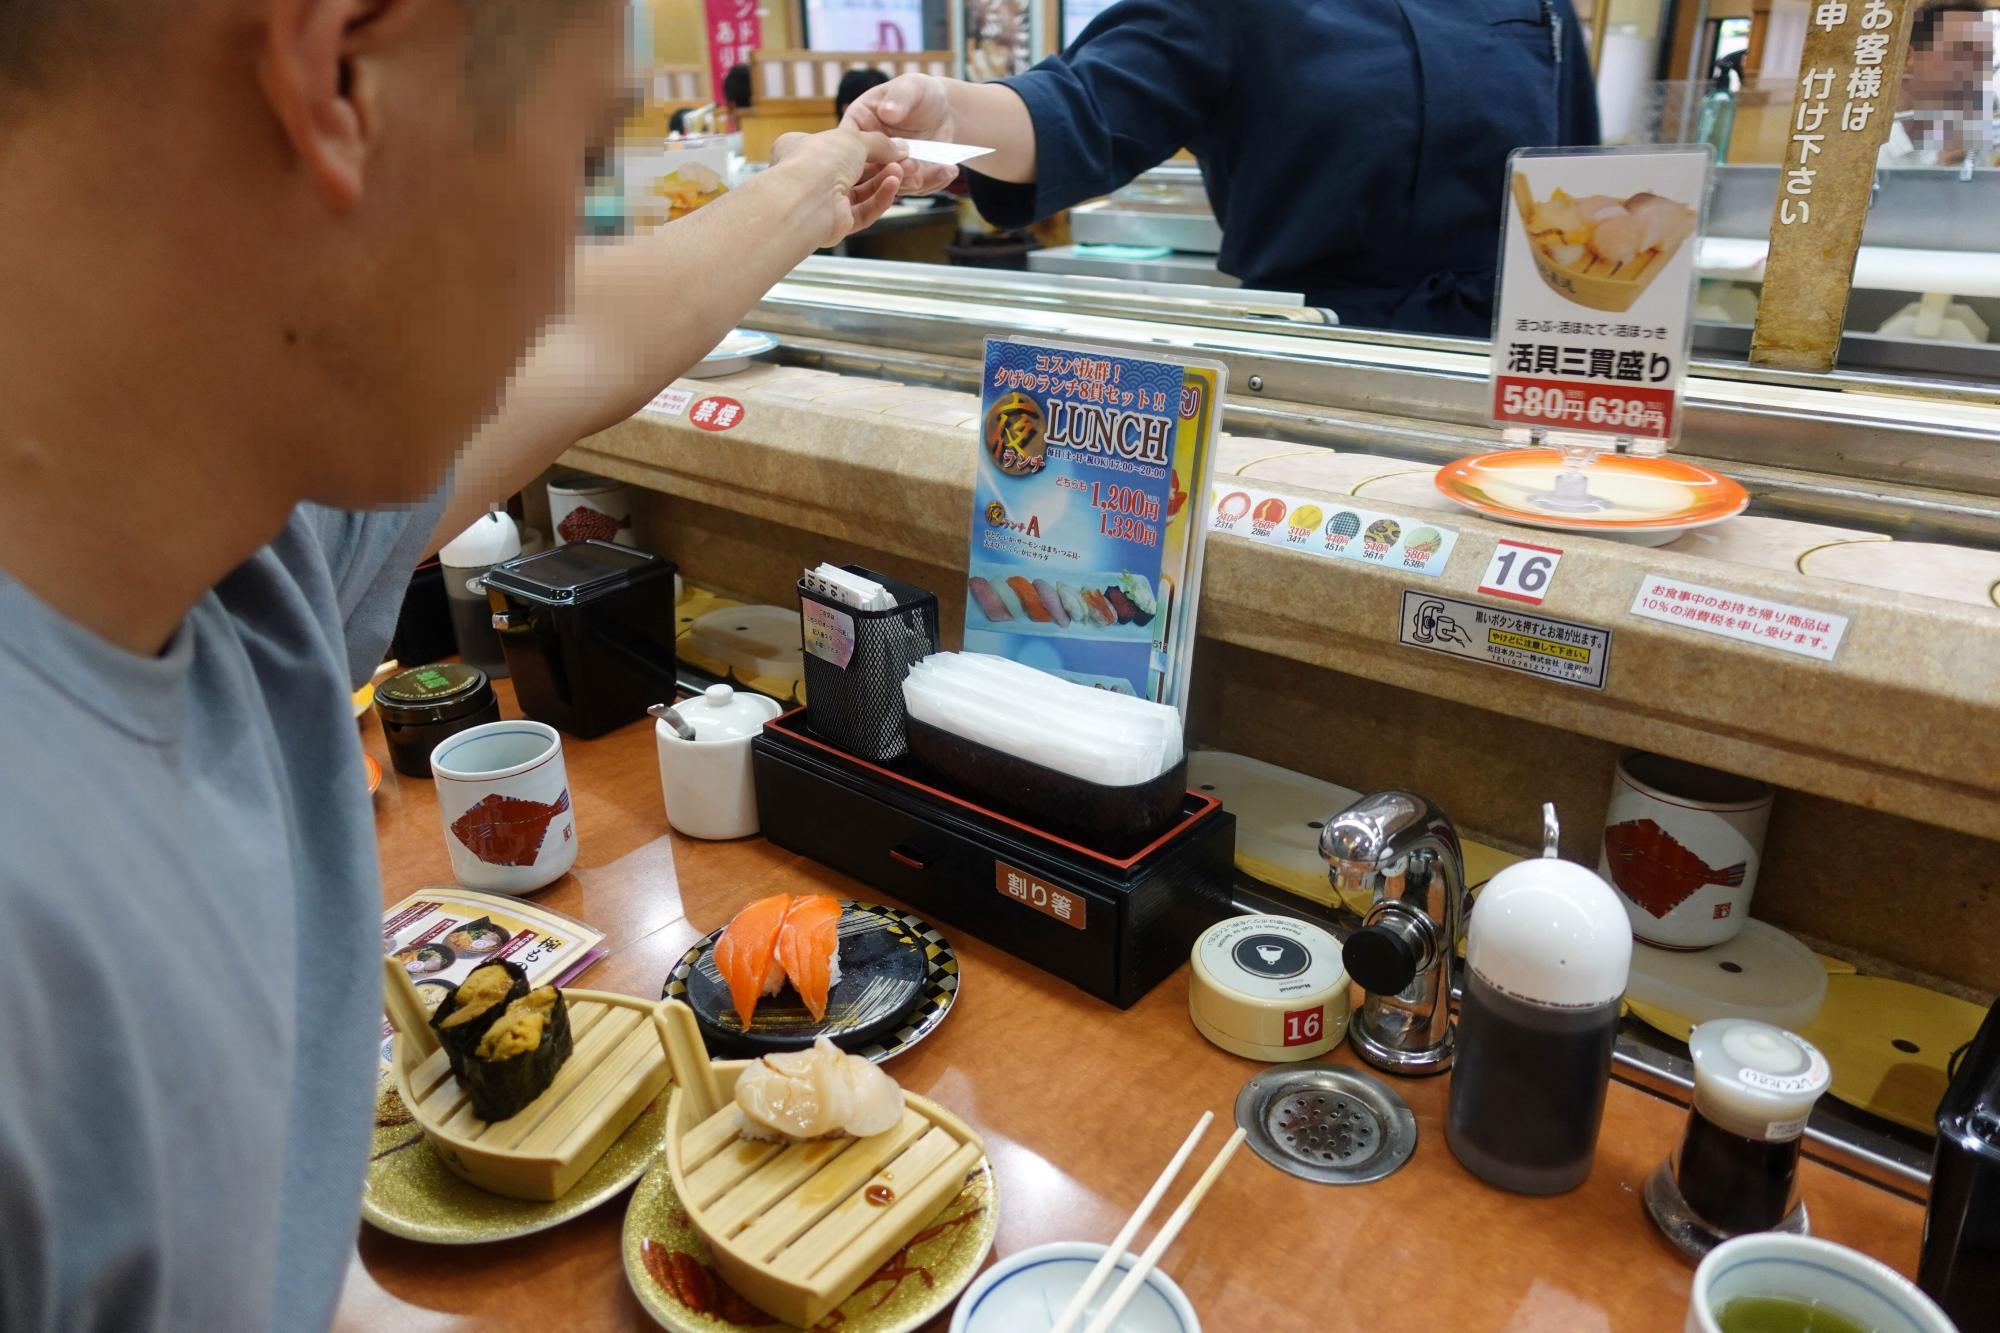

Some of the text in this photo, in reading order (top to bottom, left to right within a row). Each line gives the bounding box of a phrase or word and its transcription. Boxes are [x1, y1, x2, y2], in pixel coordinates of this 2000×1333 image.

[1841, 0, 1893, 131] お客様は
[1780, 0, 1848, 225] 申 付け下さい
[1508, 343, 1671, 382] 活貝三貫盛り
[693, 399, 741, 427] 禁煙
[1503, 385, 1585, 421] 580円
[1045, 399, 1173, 465] LUNCH
[1091, 482, 1160, 521] 1,200円
[1100, 513, 1157, 547] 1,320円
[1496, 551, 1552, 592] 16
[1651, 584, 1831, 633] お食事中のお持ち帰り商品は
[1008, 873, 1072, 920] 割り箸
[1287, 1012, 1320, 1041] 16
